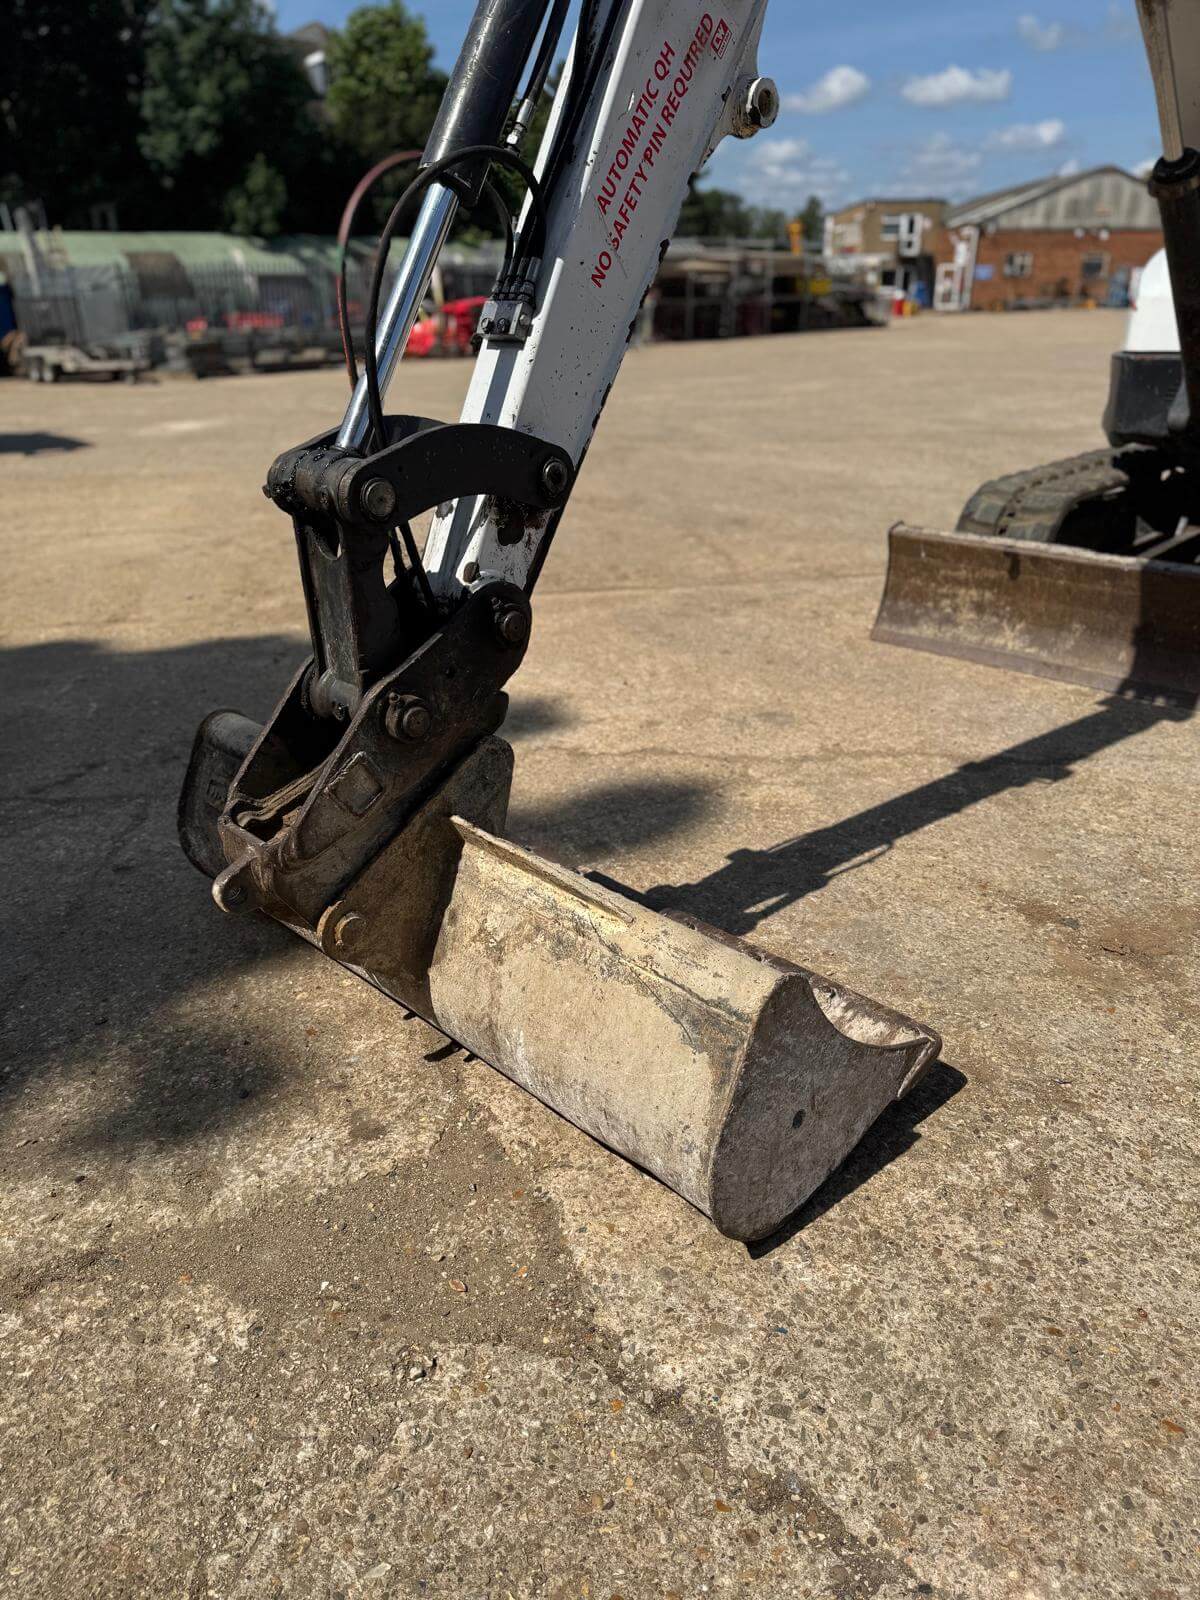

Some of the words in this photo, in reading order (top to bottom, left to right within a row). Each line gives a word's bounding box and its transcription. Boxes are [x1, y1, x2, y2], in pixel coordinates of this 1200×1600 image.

[591, 250, 613, 289] NO
[611, 164, 649, 251] SAFETY
[642, 124, 667, 167] PIN
[660, 13, 714, 127] REQUIRED
[596, 79, 660, 216] AUTOMATIC
[654, 41, 676, 82] QH
